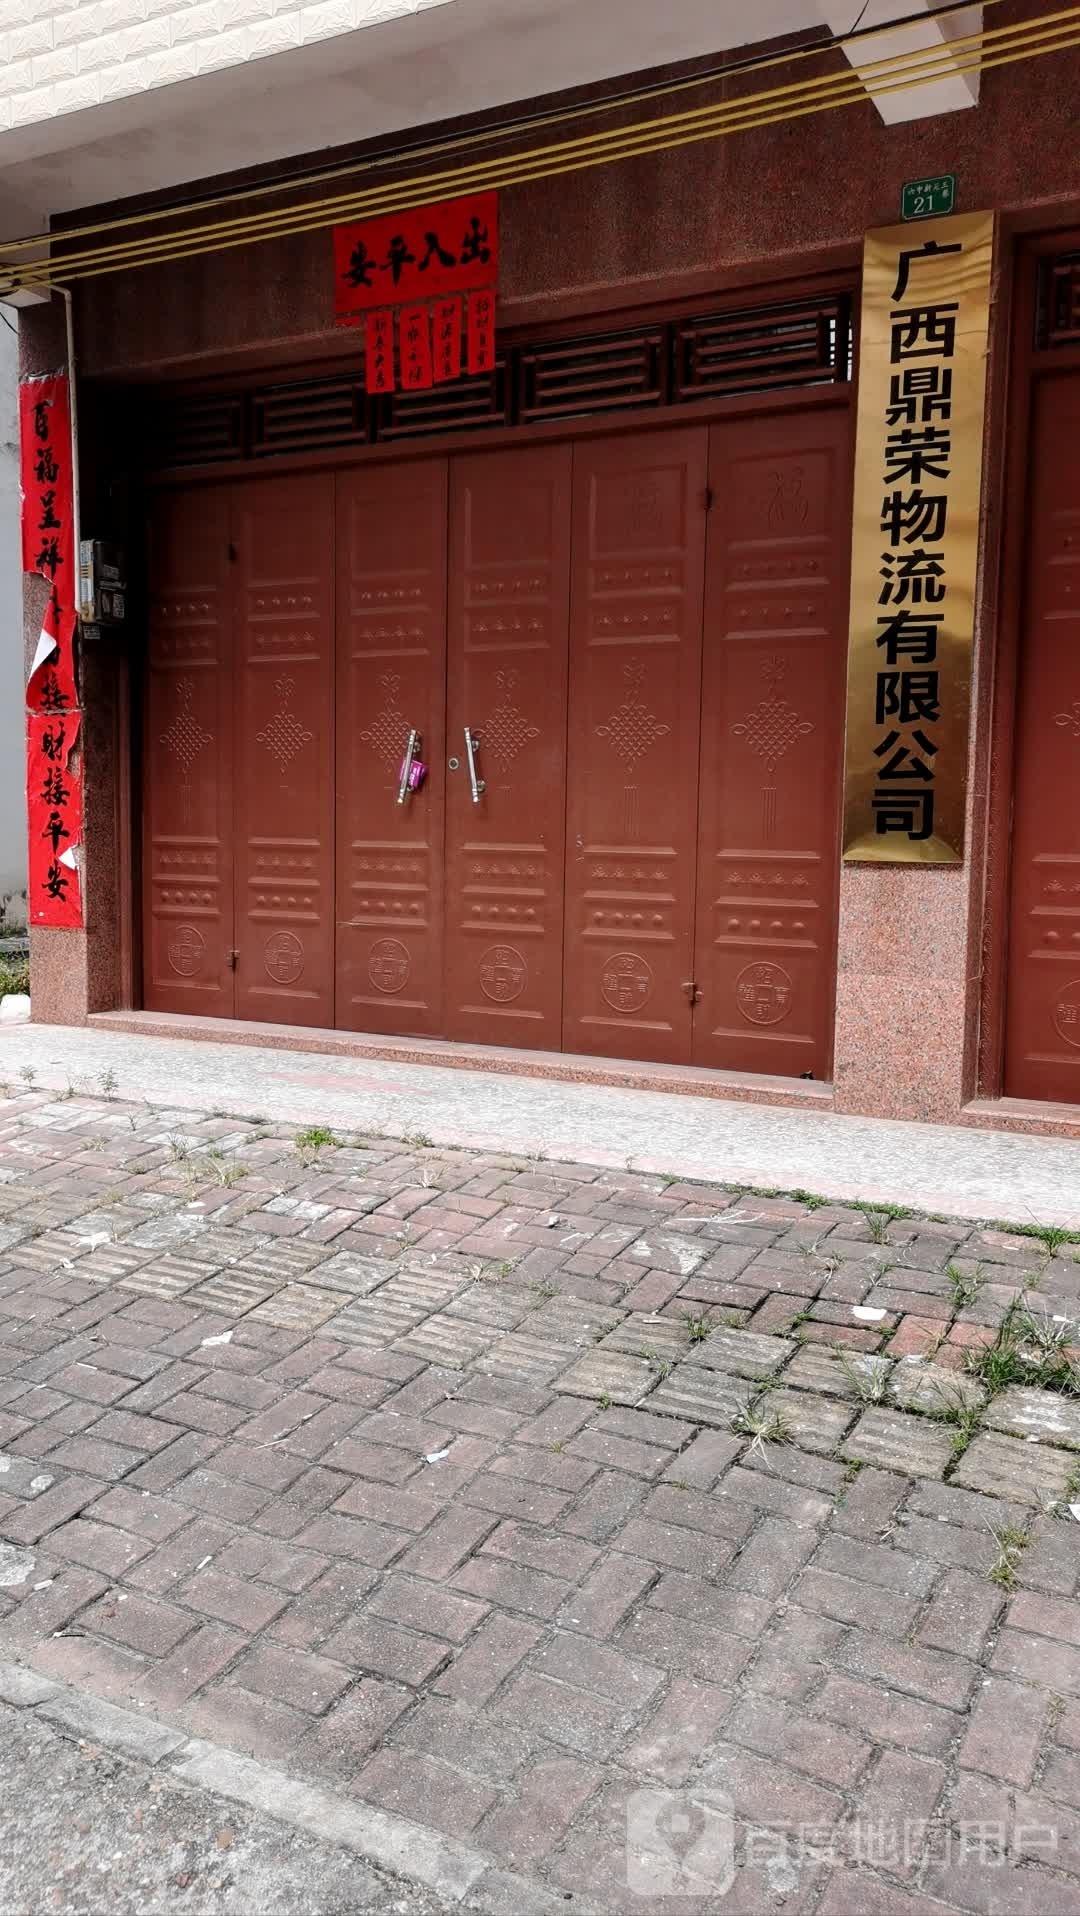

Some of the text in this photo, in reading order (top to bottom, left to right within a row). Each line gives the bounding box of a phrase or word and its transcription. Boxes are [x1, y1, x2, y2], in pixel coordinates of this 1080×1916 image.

[913, 194, 934, 214] 21
[341, 216, 491, 288] 出入平安
[871, 239, 963, 841] 广西鼎荣物流有限公司
